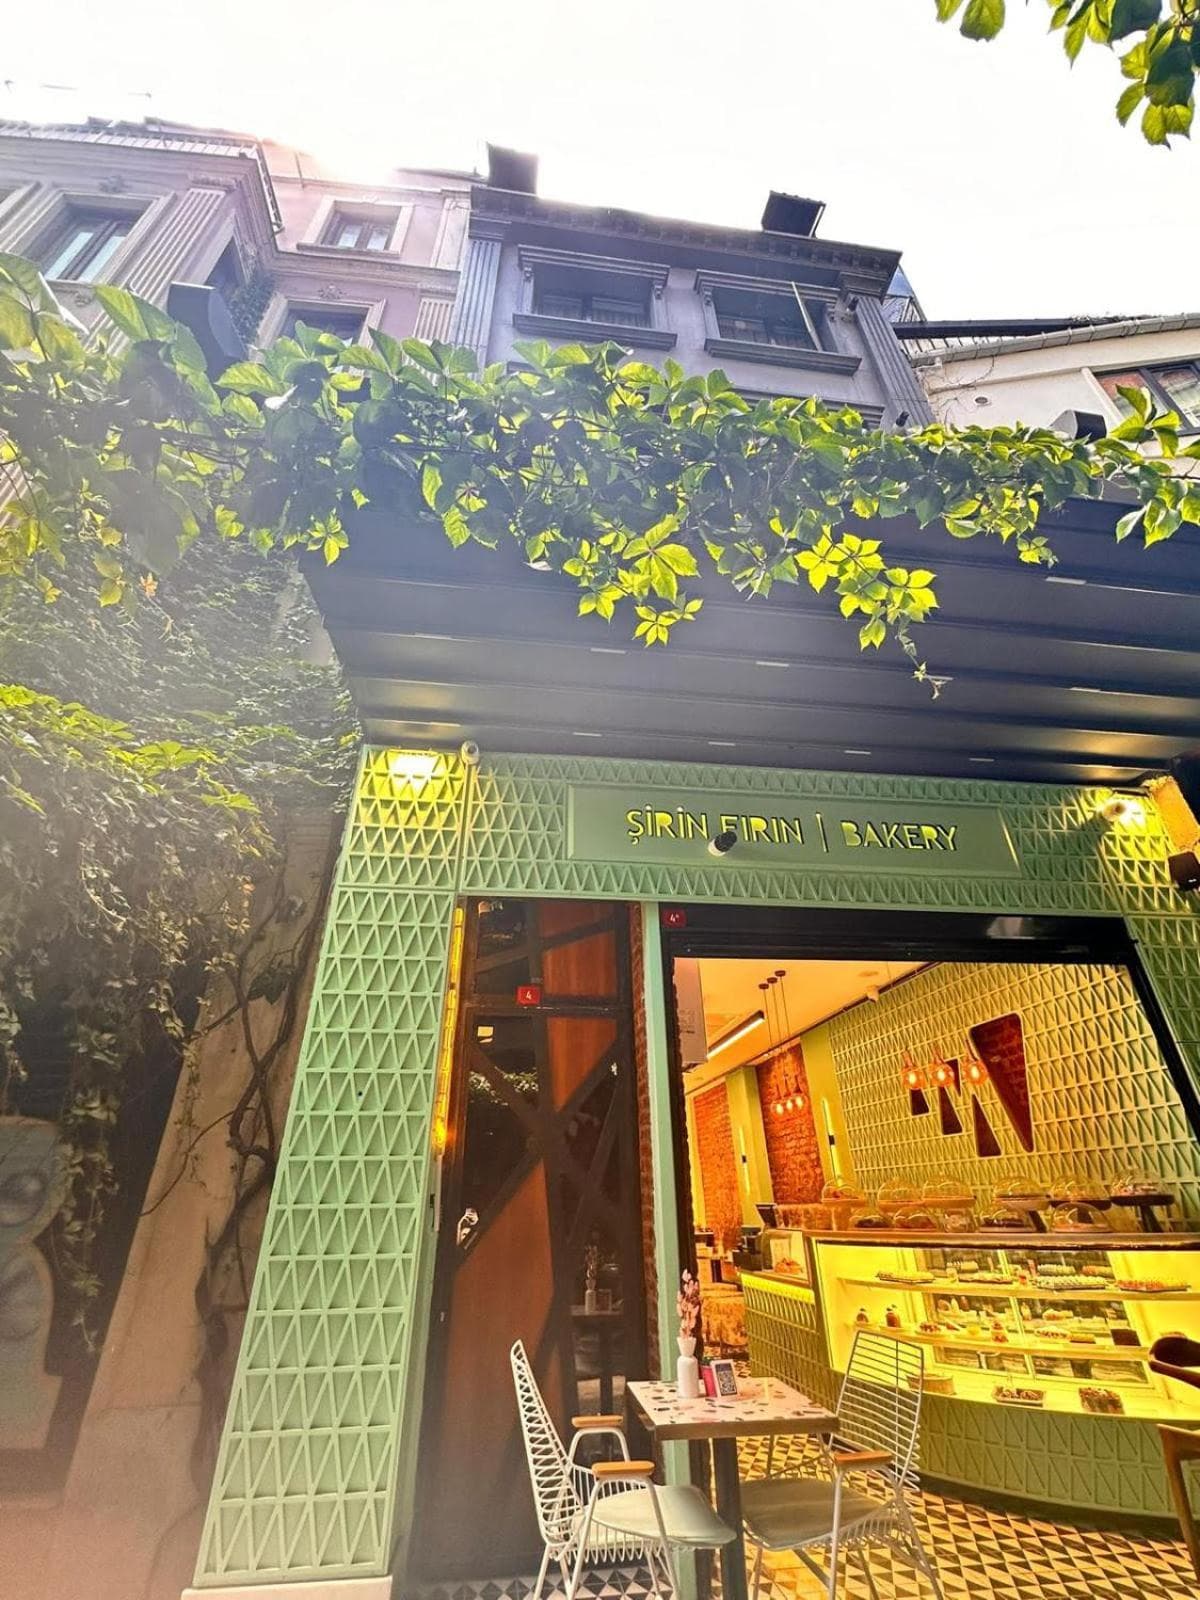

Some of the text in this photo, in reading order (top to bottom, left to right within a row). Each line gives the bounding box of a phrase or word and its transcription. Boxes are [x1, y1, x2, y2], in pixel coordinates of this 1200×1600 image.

[625, 805, 709, 845] ŞİRİN
[719, 813, 804, 845] FIRIN
[840, 819, 957, 851] BAKERY
